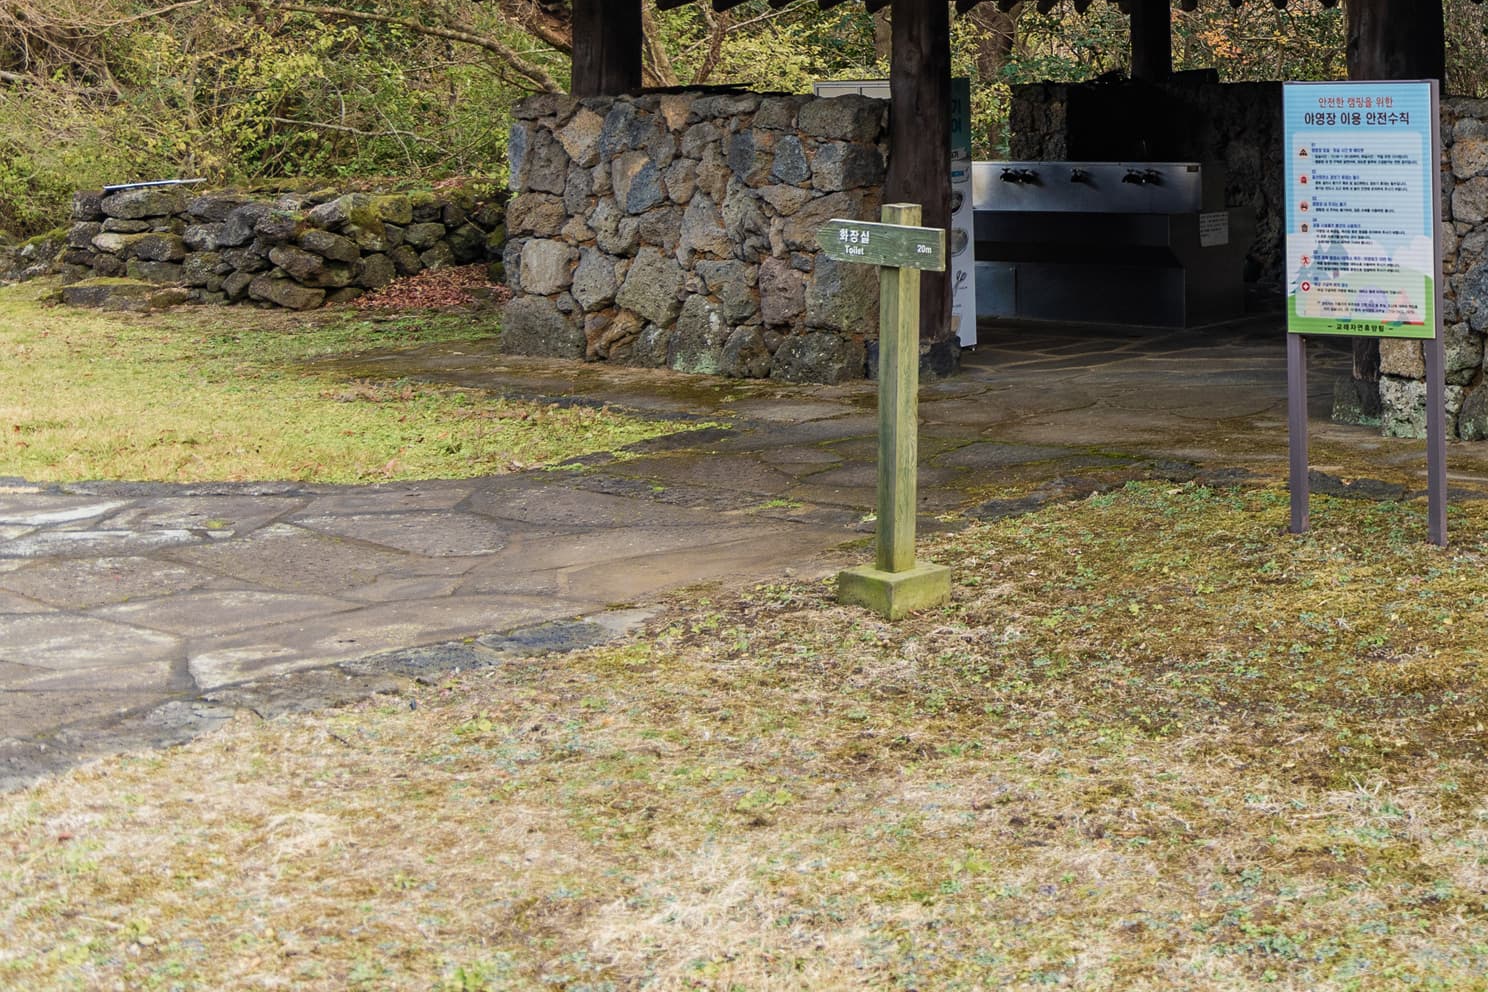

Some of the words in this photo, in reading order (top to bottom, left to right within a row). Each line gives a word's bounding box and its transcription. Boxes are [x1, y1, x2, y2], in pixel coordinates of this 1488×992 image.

[1318, 97, 1344, 108] 안전한
[1376, 96, 1393, 108] 위한
[1304, 112, 1337, 125] 야영장
[1340, 112, 1361, 125] 이용
[1366, 111, 1410, 125] 안전수칙
[839, 228, 870, 244] 화장실
[844, 245, 865, 255] Toilet
[916, 244, 932, 254] 20m
